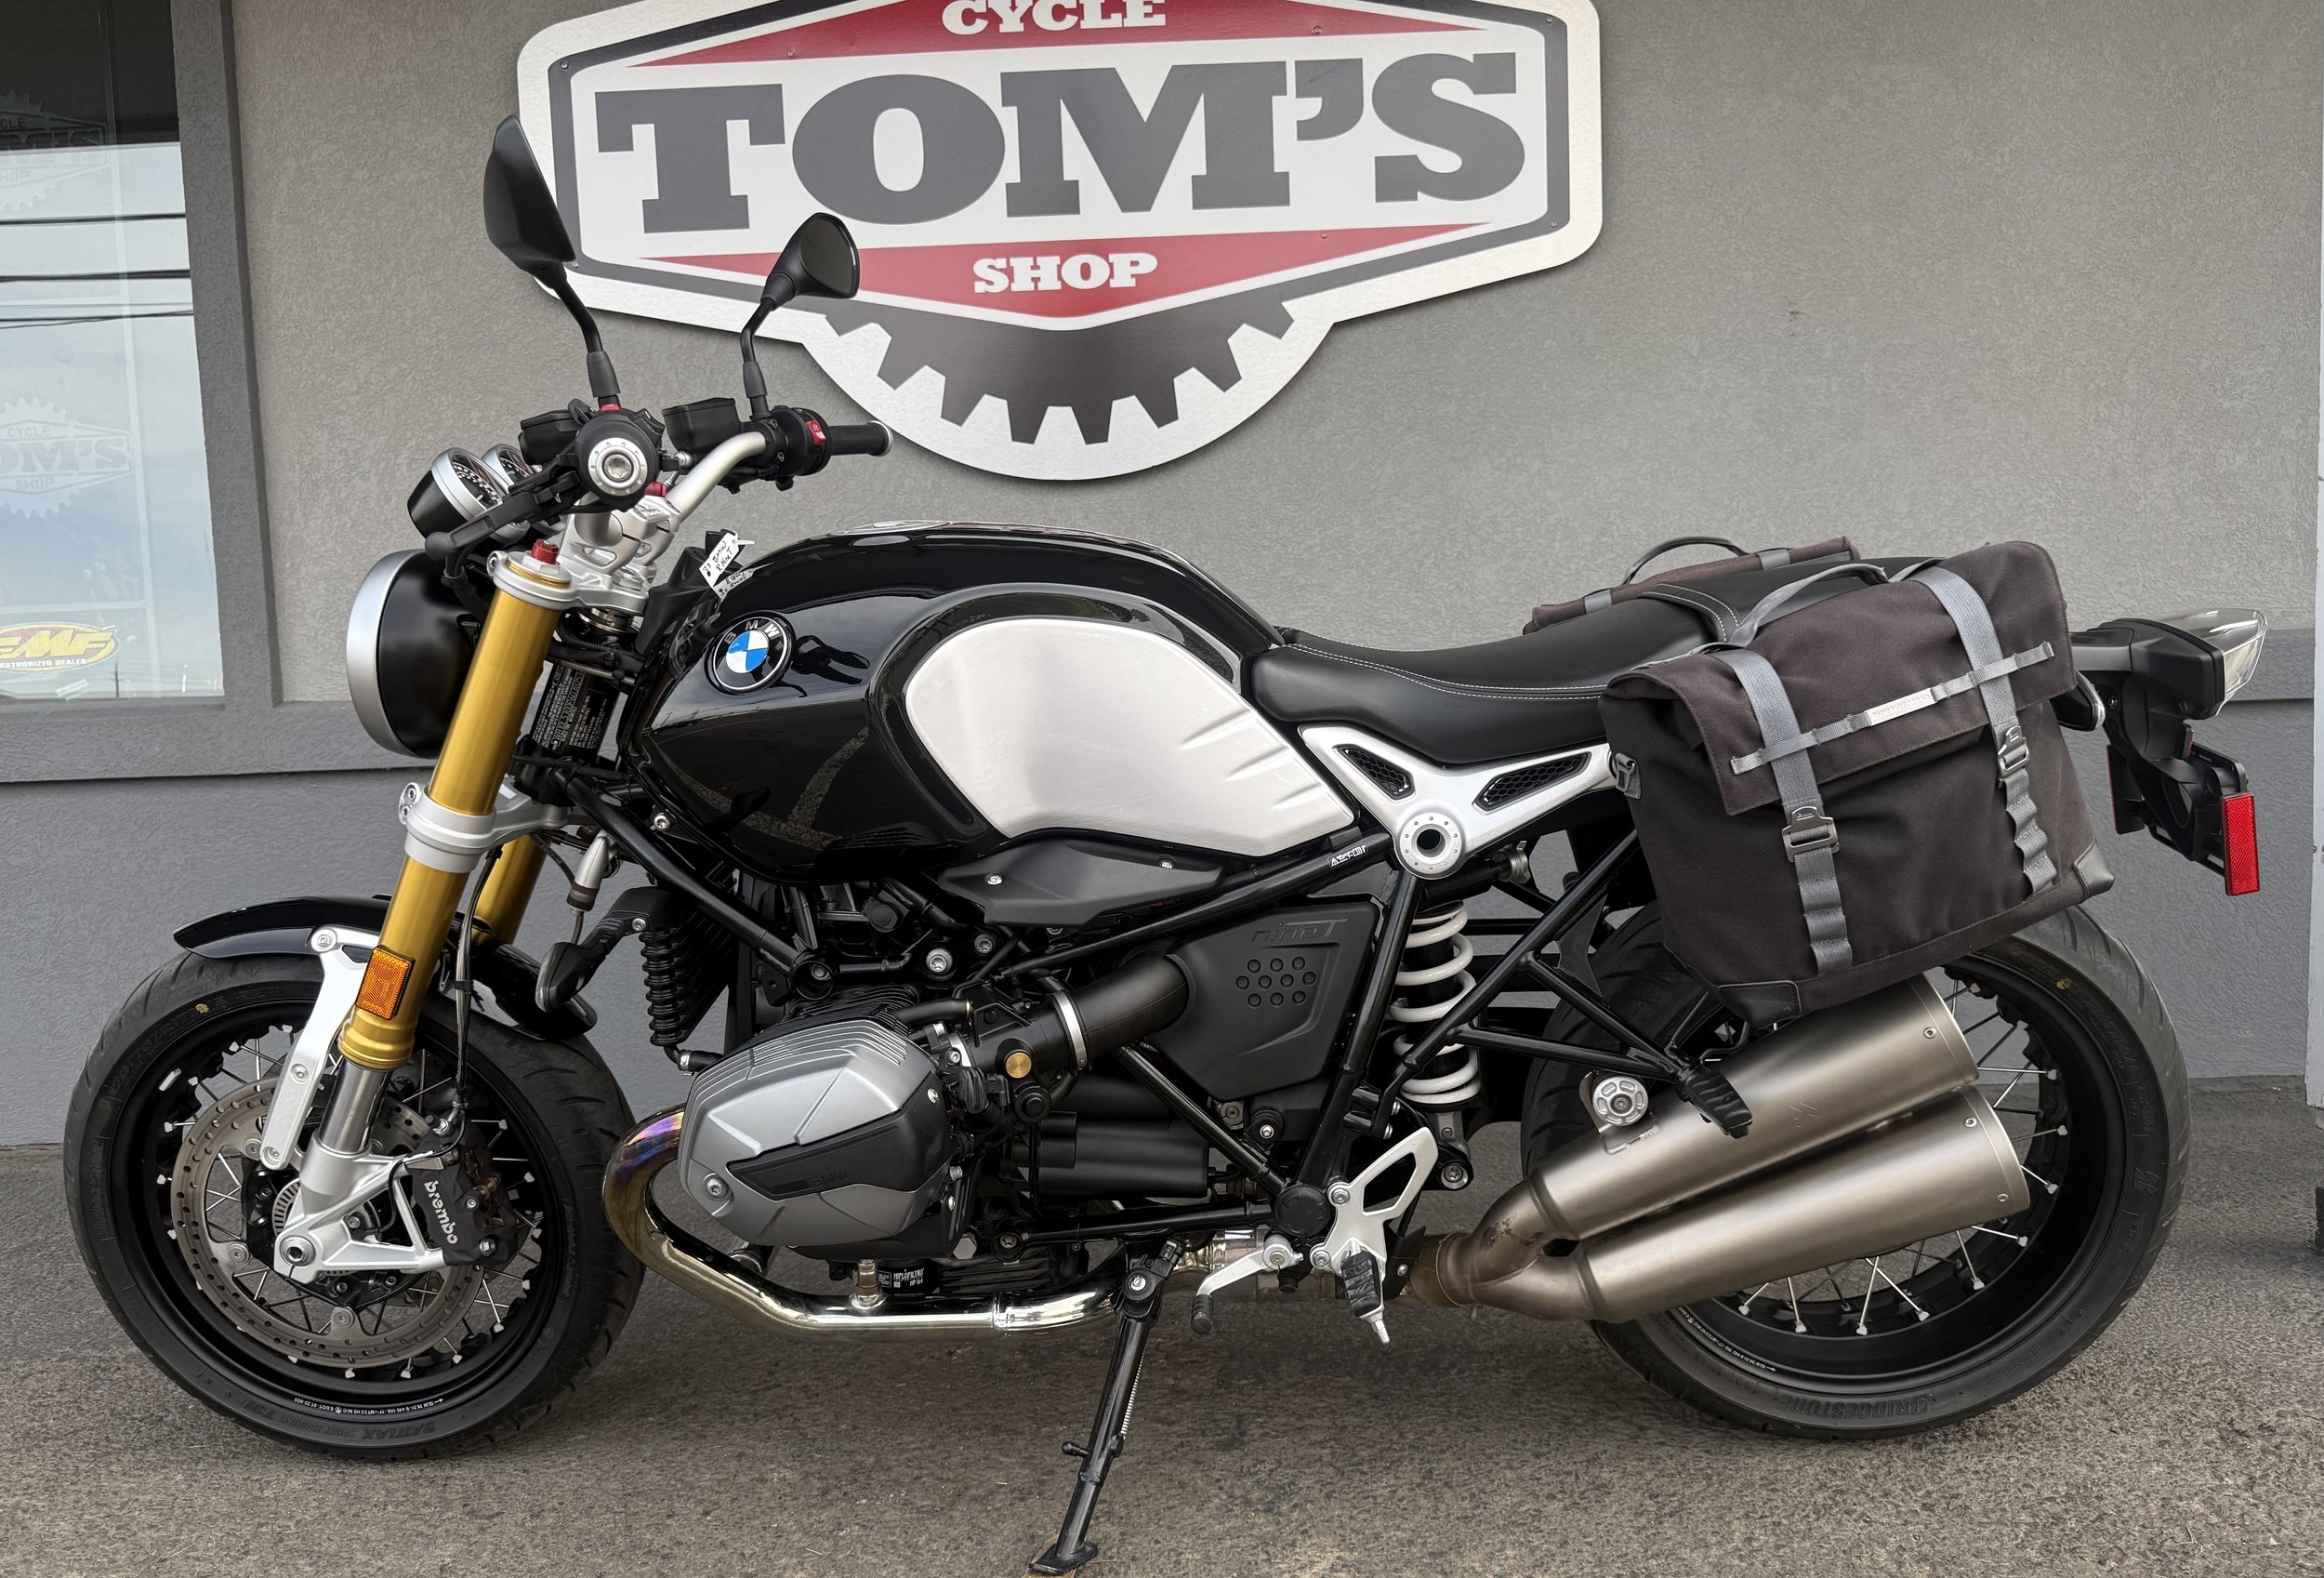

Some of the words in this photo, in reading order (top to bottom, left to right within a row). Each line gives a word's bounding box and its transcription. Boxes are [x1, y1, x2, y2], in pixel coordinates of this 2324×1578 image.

[942, 0, 1166, 35] CYCLE
[595, 52, 1525, 234] TOM'S
[973, 253, 1157, 293] SHOP
[7, 426, 51, 438] CYCLE
[15, 478, 56, 491] SHOP
[724, 619, 780, 644] BMW
[56, 658, 87, 667] DEALER
[424, 1180, 458, 1244] brembo
[1777, 1393, 1929, 1419] BRIDGESTONE
